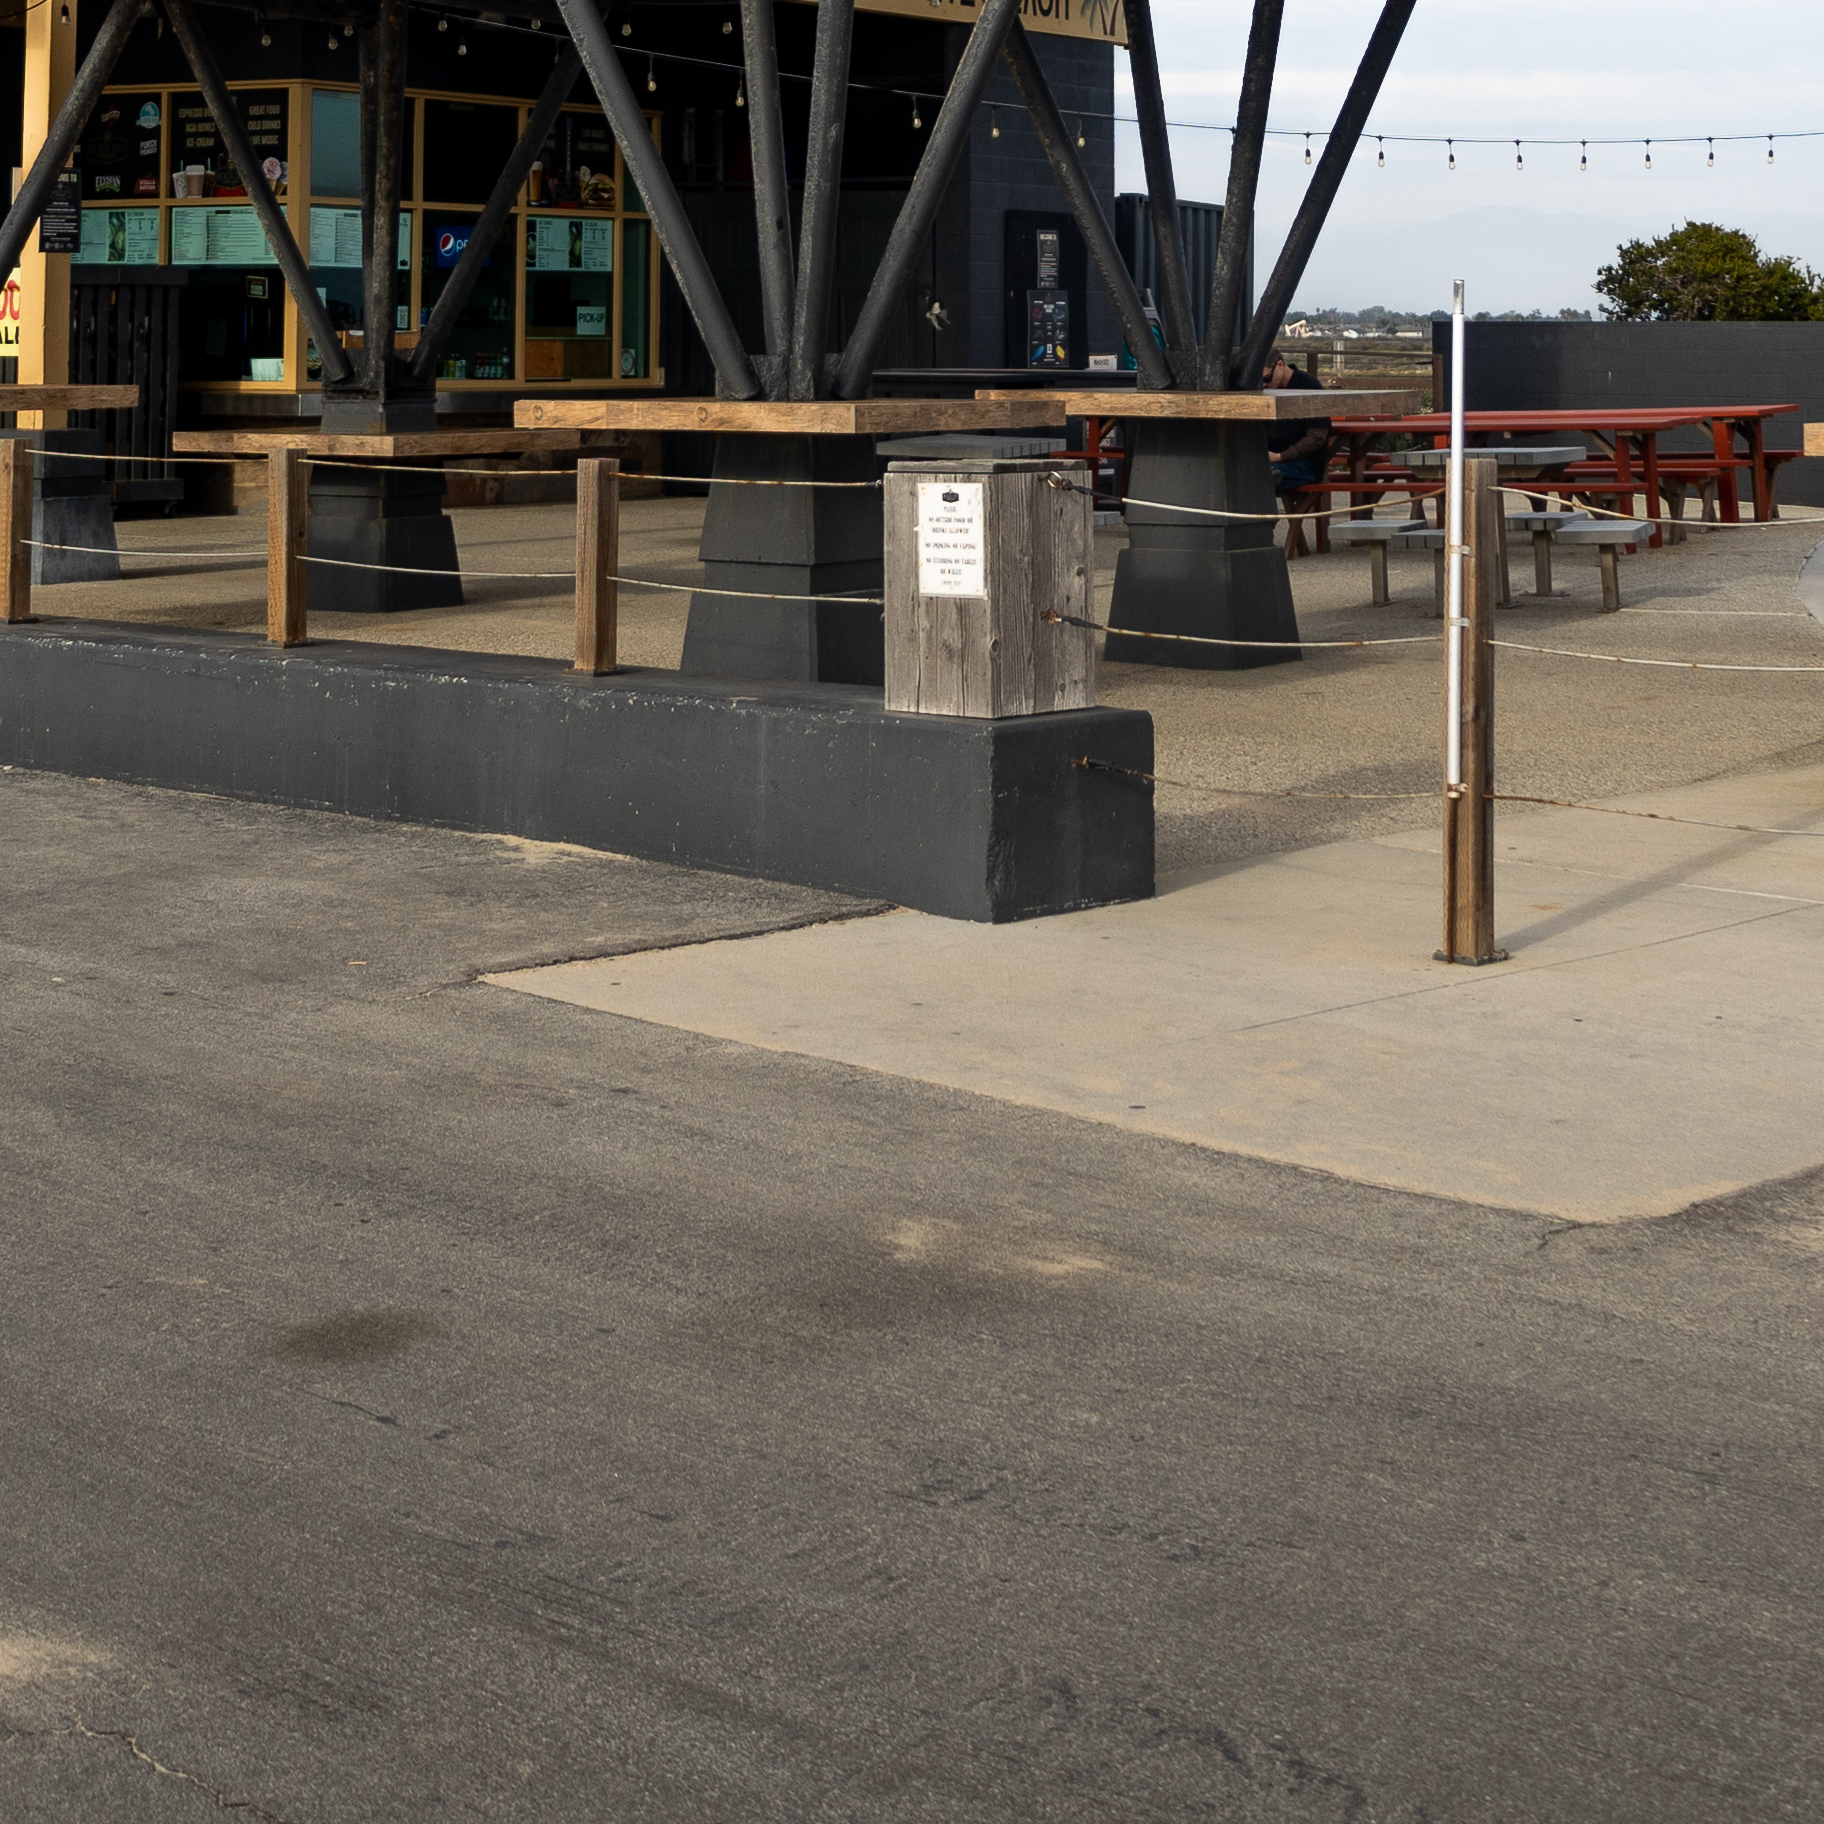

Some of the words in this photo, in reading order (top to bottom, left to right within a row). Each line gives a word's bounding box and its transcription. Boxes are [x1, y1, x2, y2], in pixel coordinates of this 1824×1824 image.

[249, 105, 265, 115] GREAT
[266, 105, 281, 115] FOOD
[262, 120, 281, 130] DRINKS
[578, 312, 605, 323] PICK-UP
